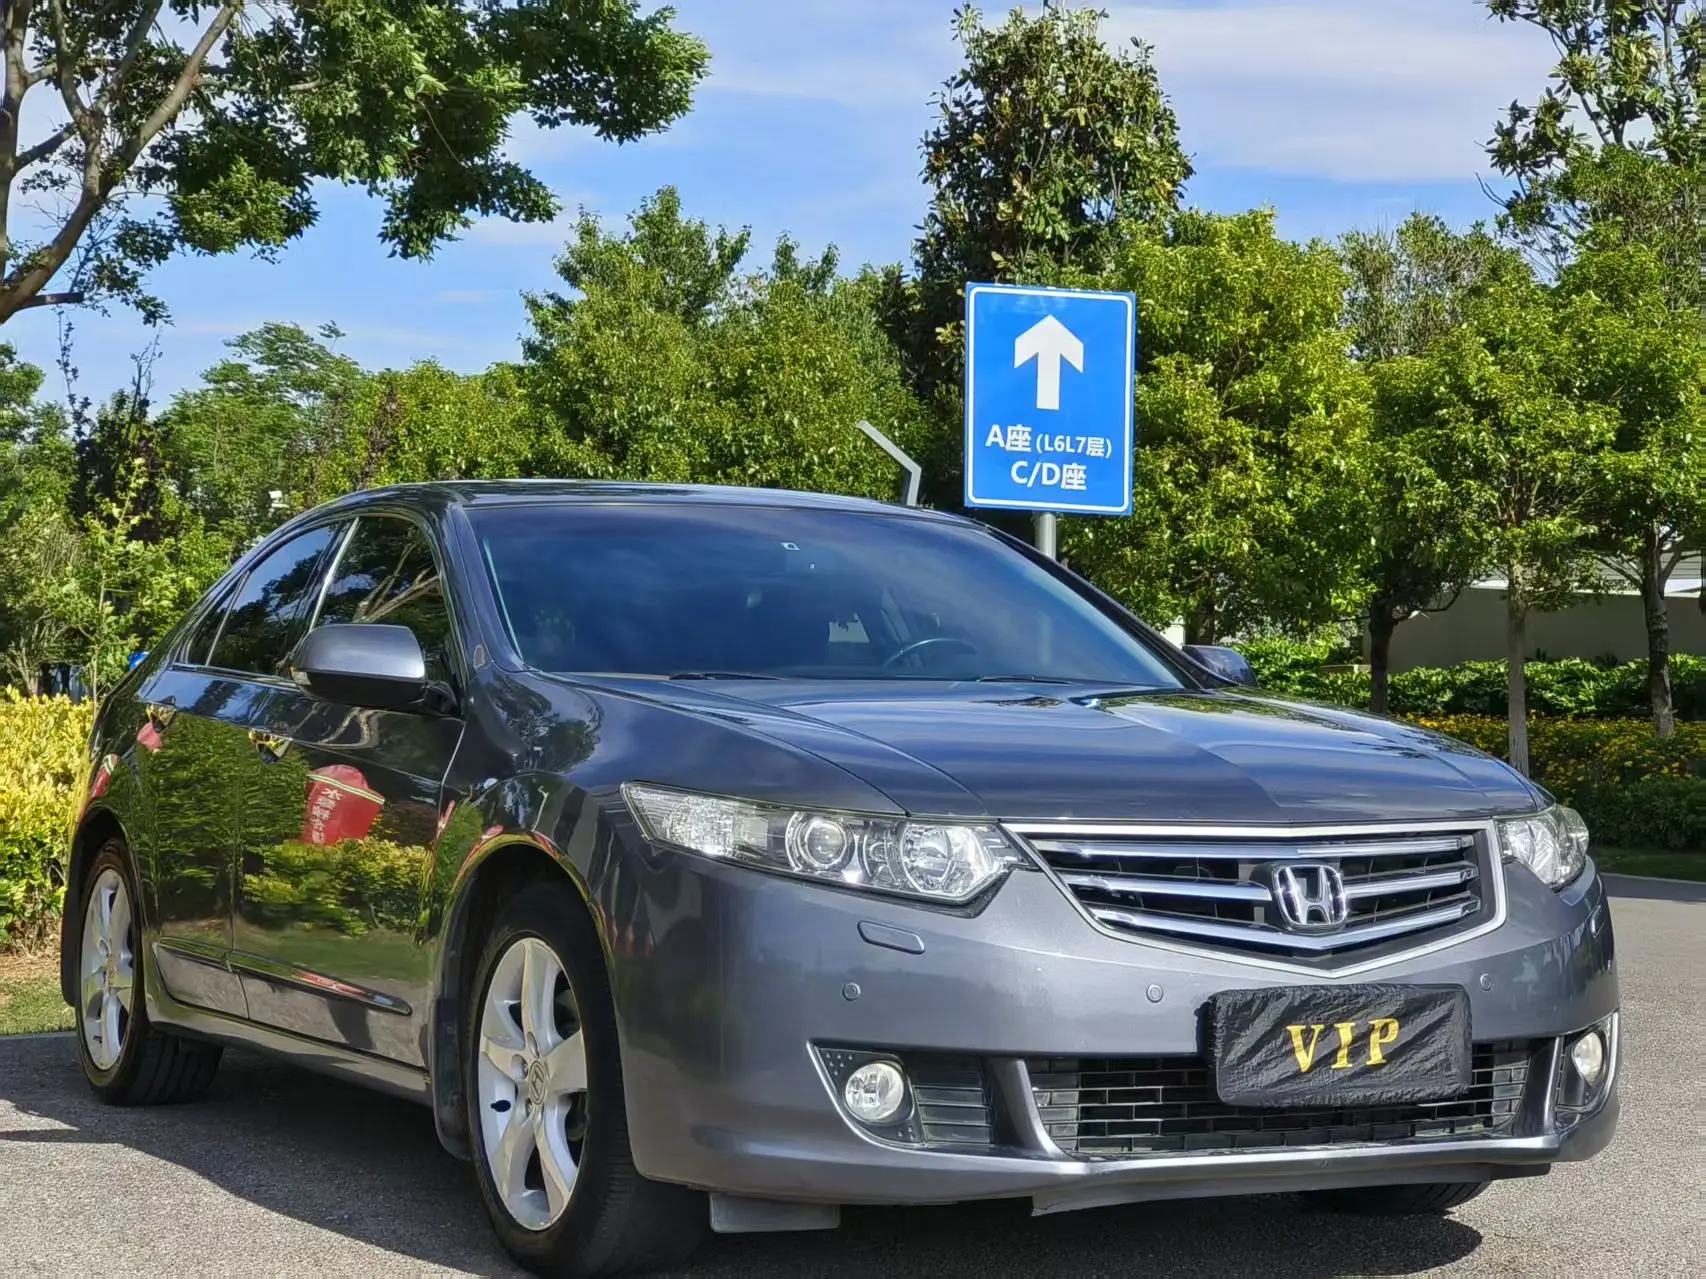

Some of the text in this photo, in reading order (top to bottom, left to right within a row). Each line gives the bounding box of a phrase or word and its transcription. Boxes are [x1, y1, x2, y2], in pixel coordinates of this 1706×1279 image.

[985, 423, 1032, 452] A座
[1010, 460, 1087, 491] C/D座
[1286, 1018, 1399, 1072] VIP
